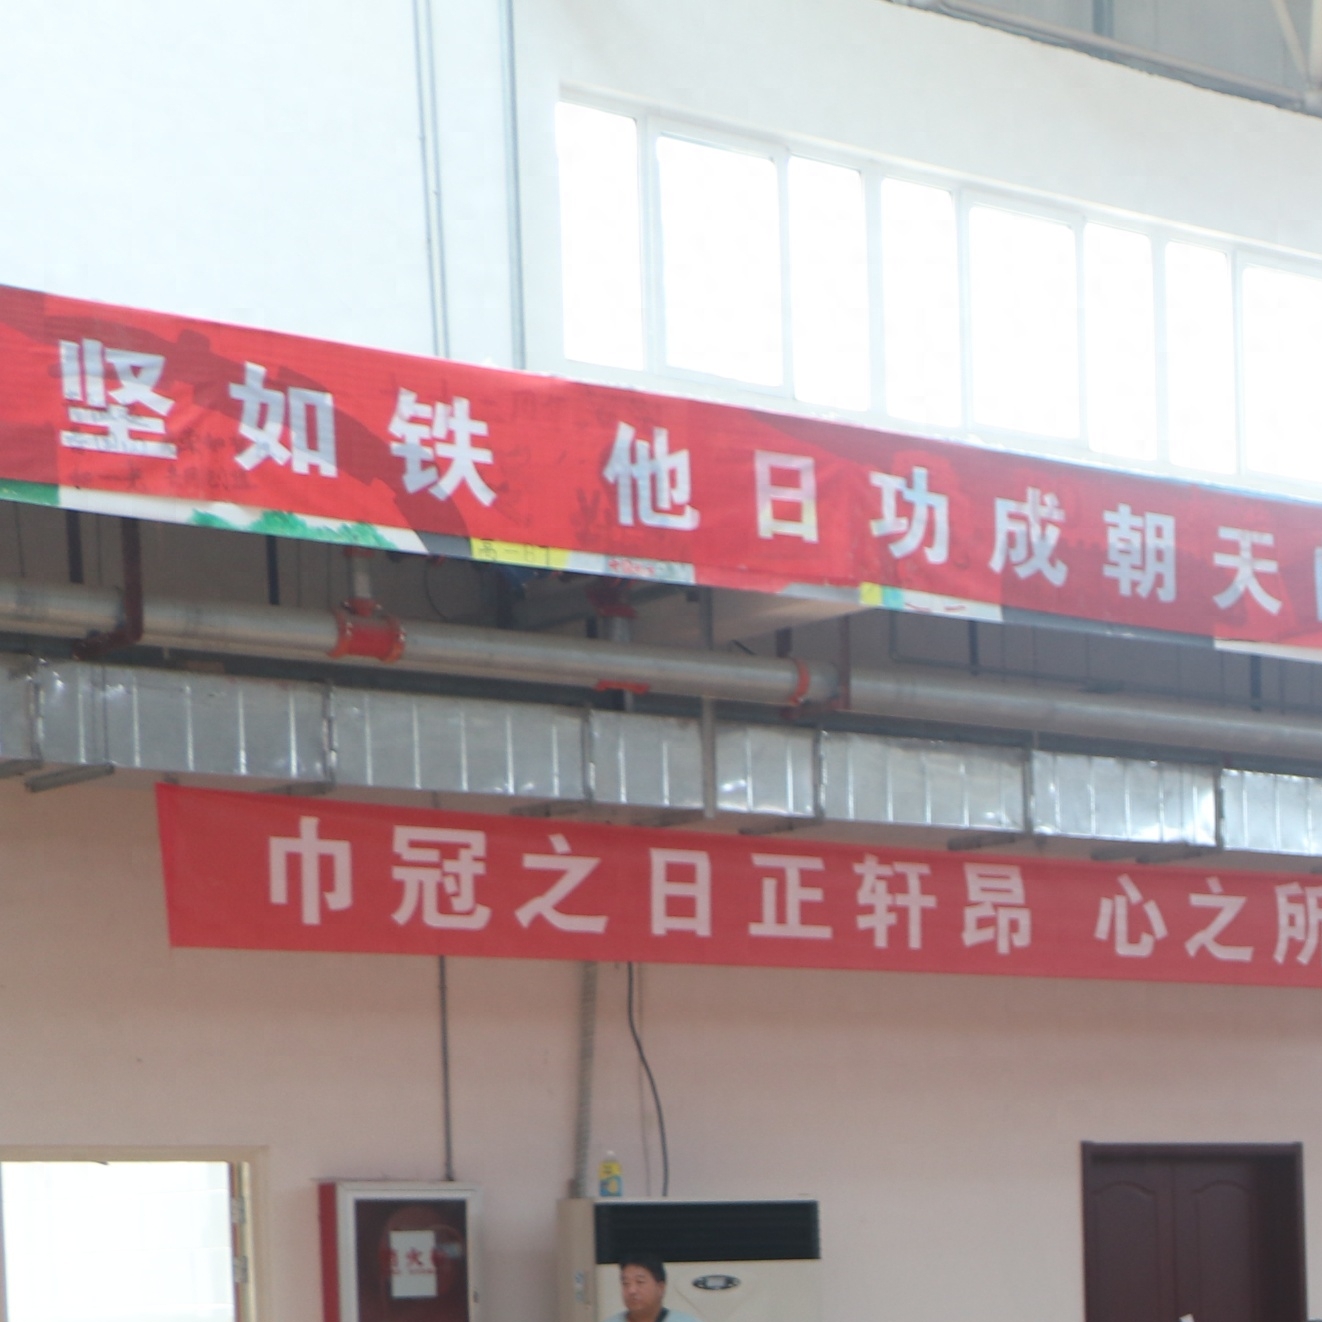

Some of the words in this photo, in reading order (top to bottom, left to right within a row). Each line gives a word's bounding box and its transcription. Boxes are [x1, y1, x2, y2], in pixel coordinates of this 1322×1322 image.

[58, 338, 498, 507] 坚如铁
[266, 816, 1032, 955] 巾冠之日正轩昂
